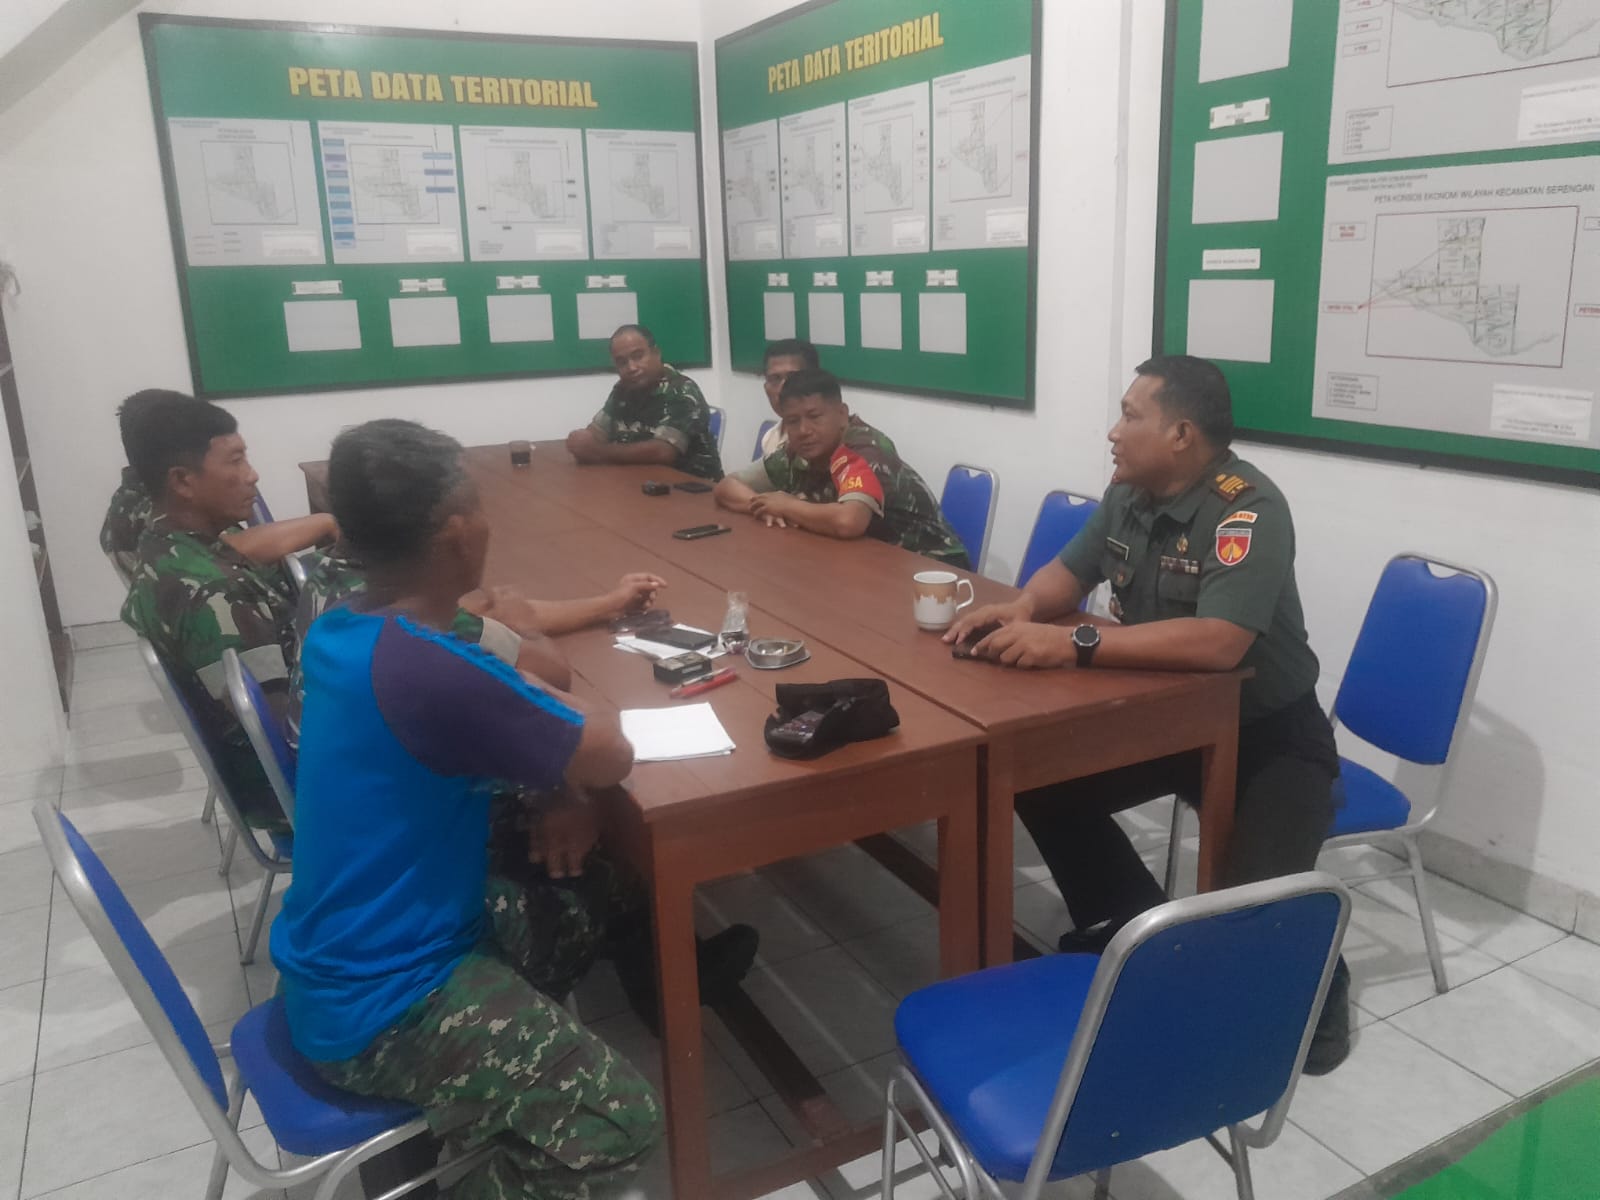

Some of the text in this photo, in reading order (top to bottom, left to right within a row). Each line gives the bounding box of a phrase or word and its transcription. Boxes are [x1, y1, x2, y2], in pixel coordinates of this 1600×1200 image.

[768, 12, 944, 94] PETA DATA TERITORIAL
[289, 67, 598, 108] PETA DATA TERITORIAL
[1495, 185, 1544, 198] KECAMATAN
[1546, 183, 1595, 196] SERENGAN
